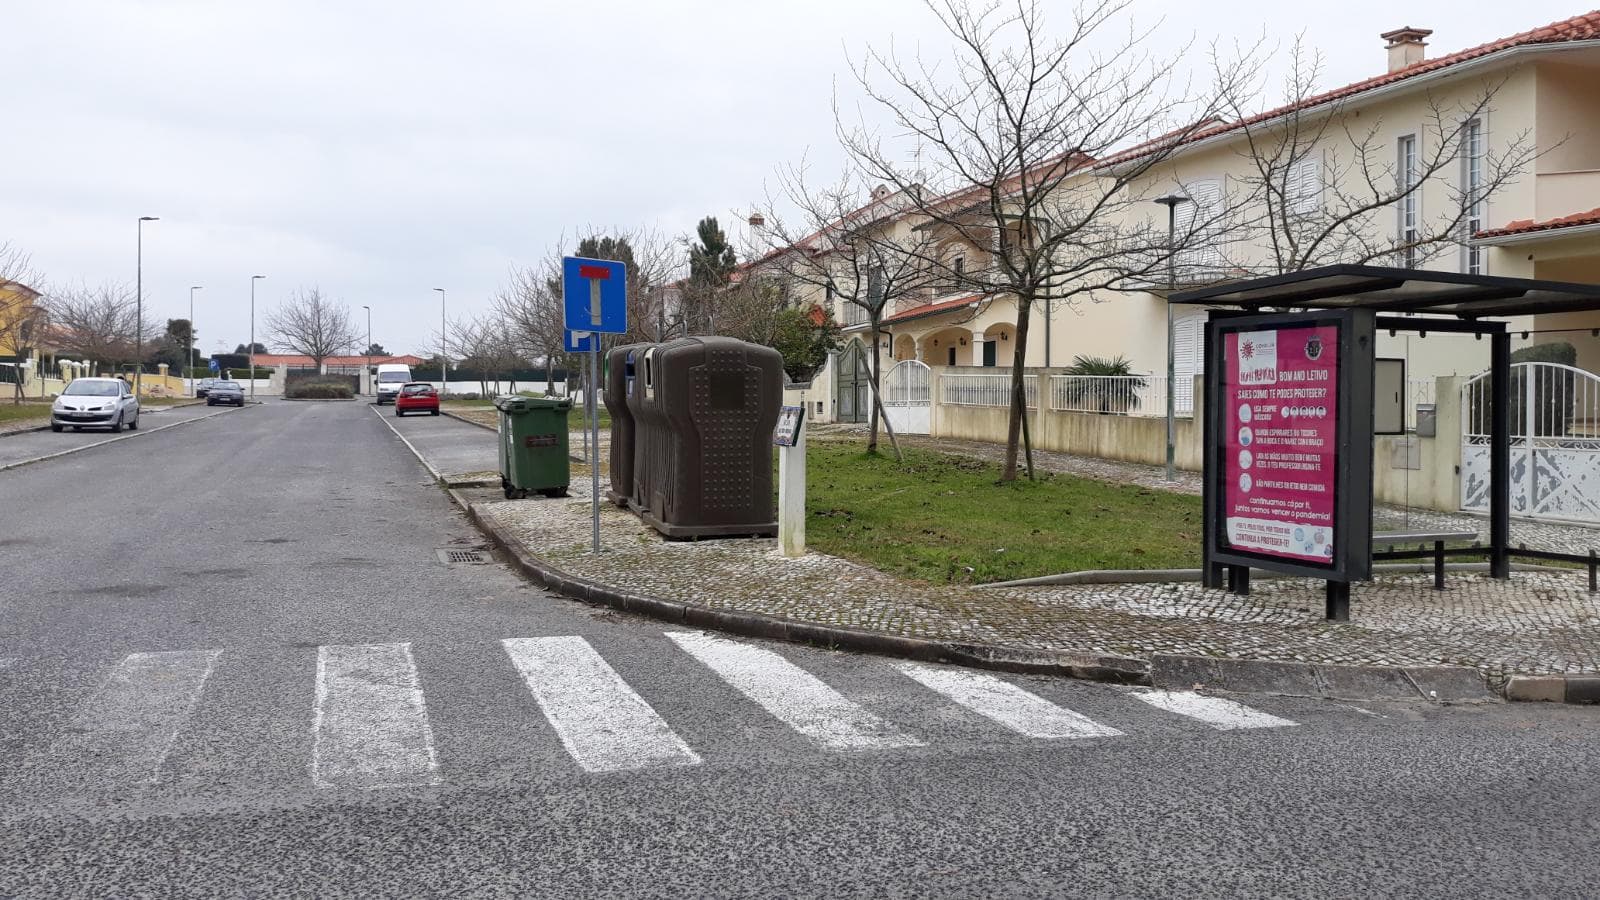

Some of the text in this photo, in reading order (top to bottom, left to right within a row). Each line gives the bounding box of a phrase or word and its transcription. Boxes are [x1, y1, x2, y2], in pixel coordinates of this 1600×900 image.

[1279, 371, 1293, 381] BOM
[1293, 371, 1305, 381] ANO
[1307, 369, 1328, 381] LETIVO
[1269, 389, 1276, 398] TE
[1276, 389, 1293, 399] PODES
[1249, 497, 1286, 506] continuamos
[1294, 501, 1304, 510] por
[1235, 504, 1250, 513] juntos
[1271, 508, 1290, 516] vencer
[1295, 510, 1331, 520] pandemia!
